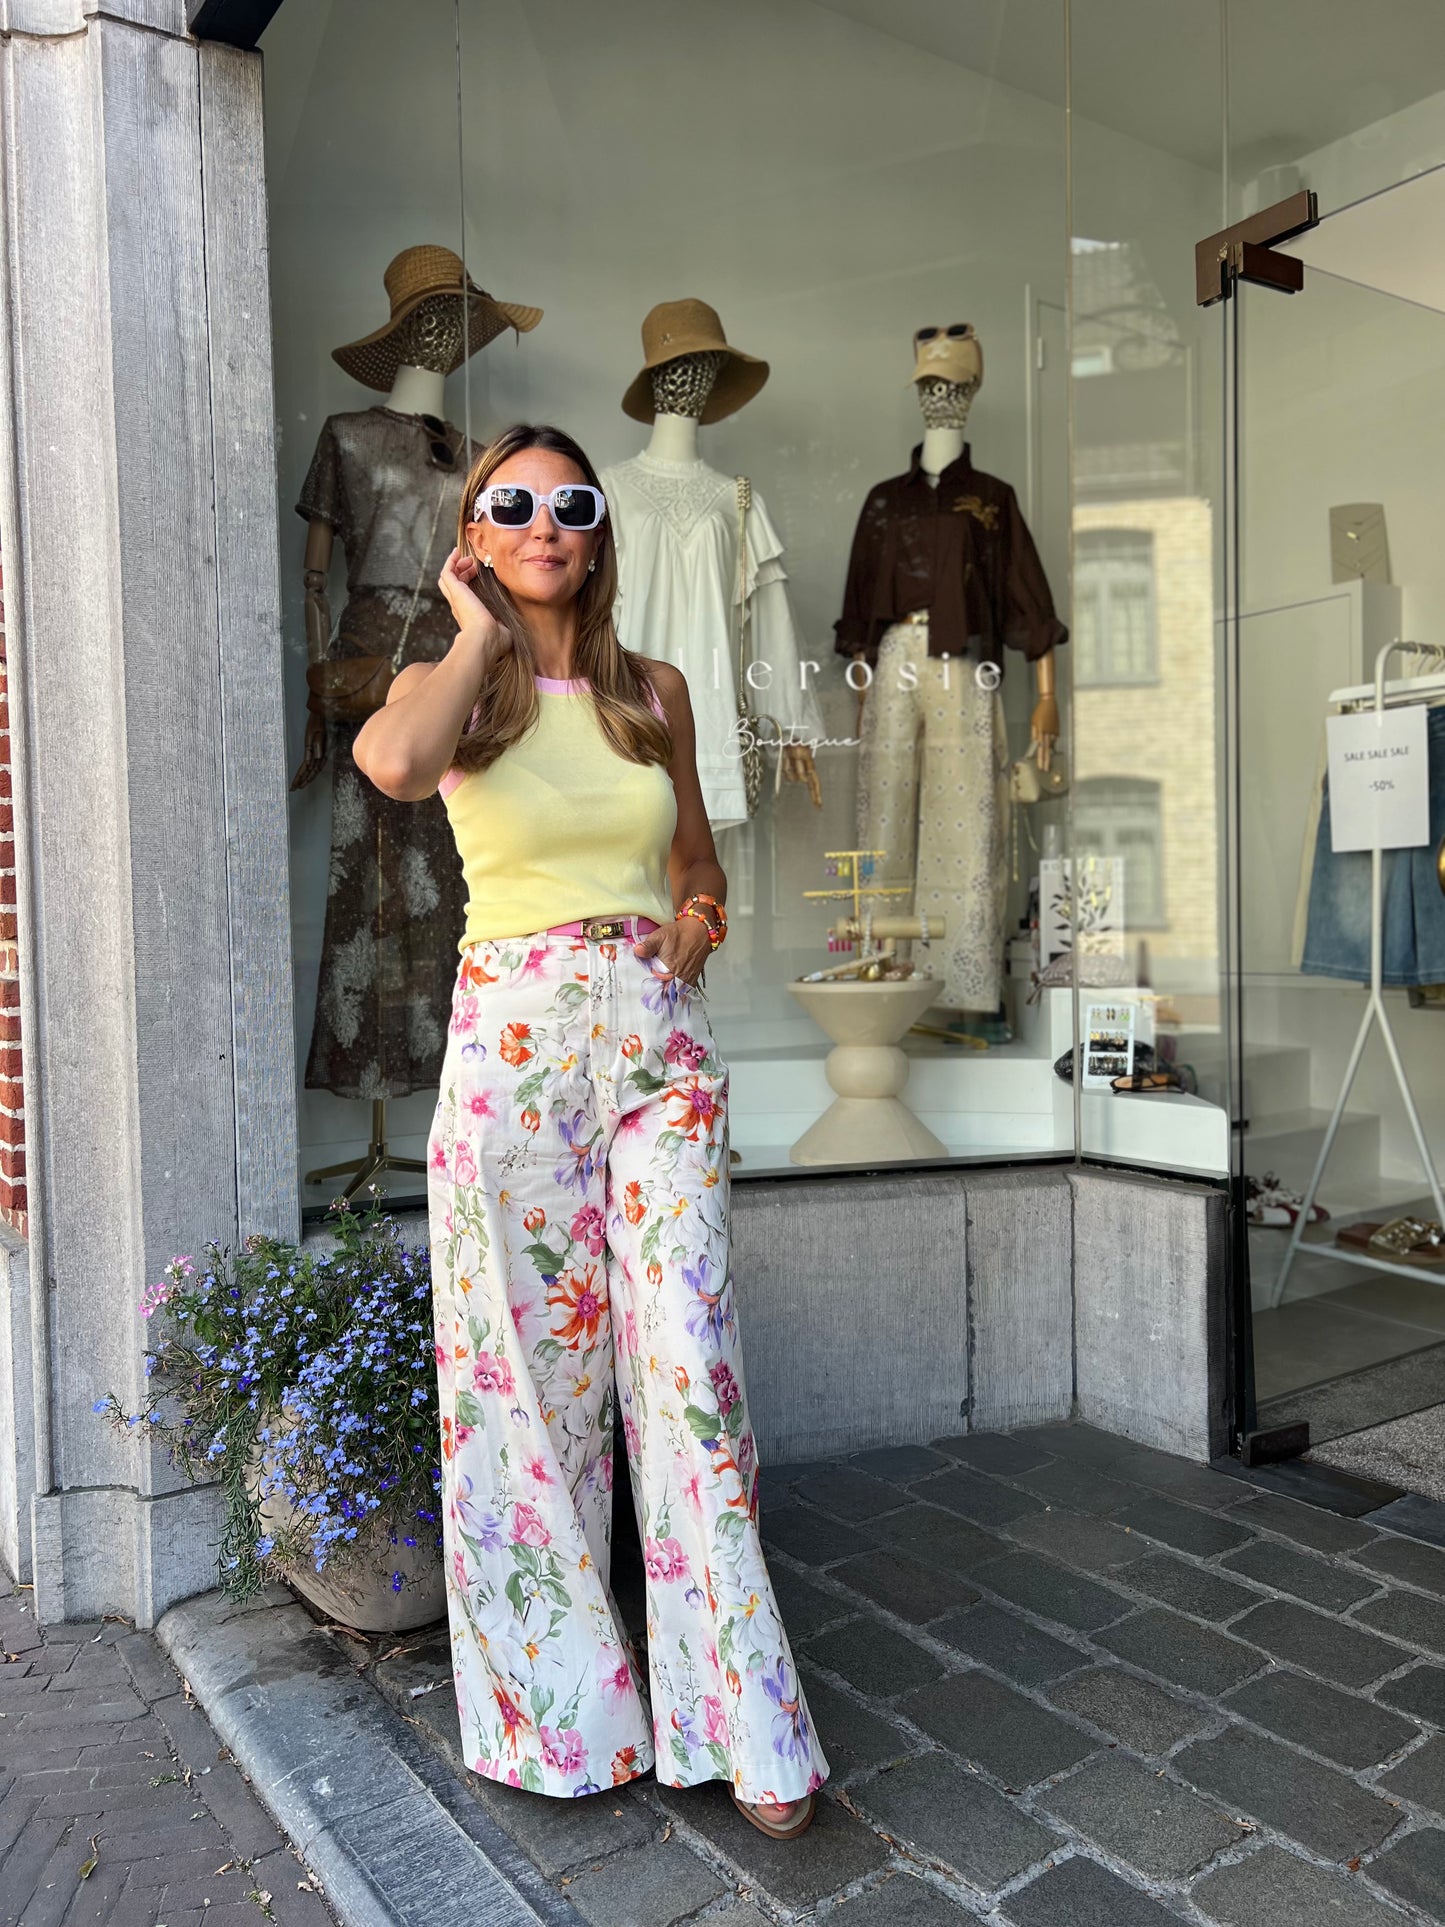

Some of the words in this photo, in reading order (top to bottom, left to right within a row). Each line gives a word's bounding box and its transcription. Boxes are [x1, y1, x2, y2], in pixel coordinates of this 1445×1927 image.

[722, 718, 861, 759] Boutique
[1344, 751, 1364, 762] SALE
[1367, 748, 1387, 760] SALE
[1390, 745, 1409, 757] SALE
[1369, 780, 1395, 792] -50%
